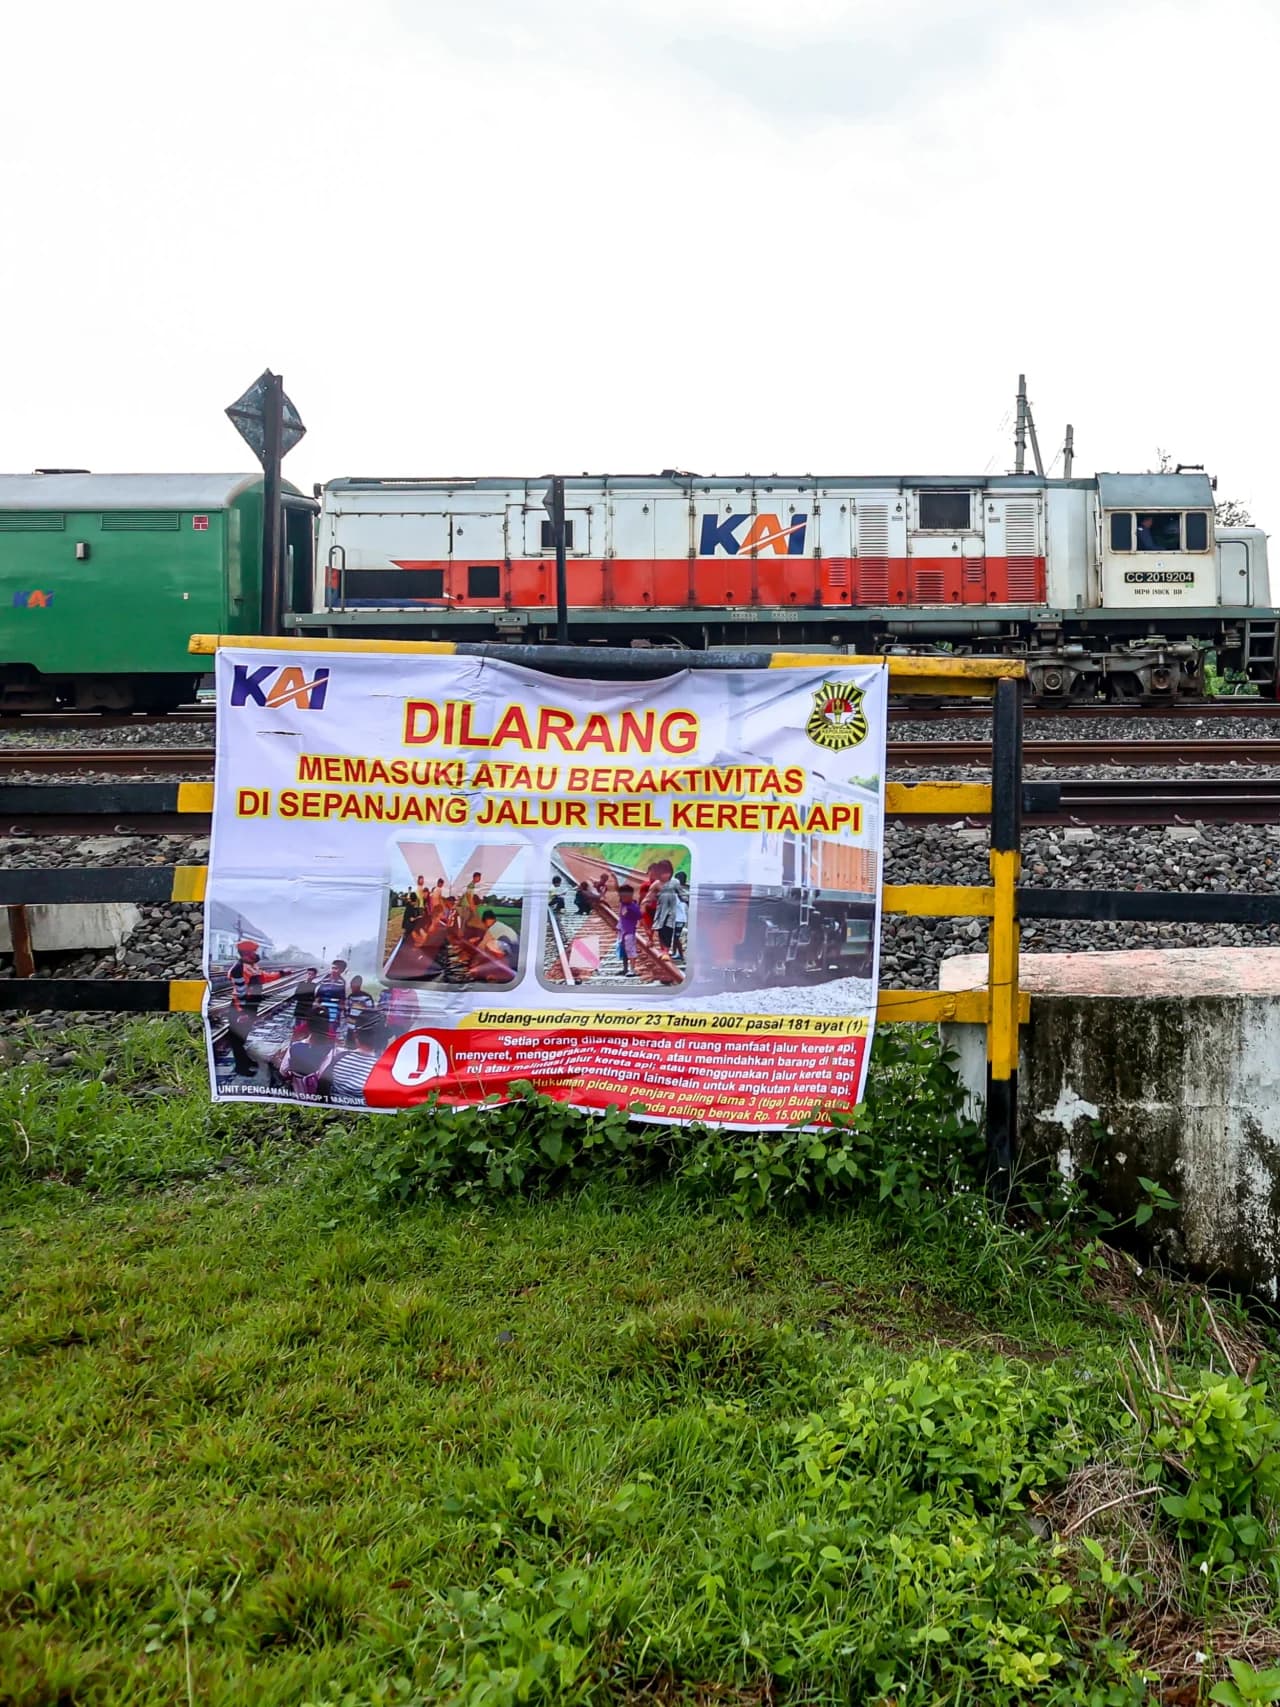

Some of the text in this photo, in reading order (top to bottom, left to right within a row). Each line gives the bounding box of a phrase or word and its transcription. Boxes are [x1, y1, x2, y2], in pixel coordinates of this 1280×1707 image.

[699, 513, 808, 556] KAI
[1126, 572, 1193, 582] CC 2019204
[12, 590, 56, 608] KAI
[230, 664, 330, 711] KAI
[402, 700, 699, 755] DILARANG
[297, 755, 804, 795] MEMASUKI ATAU BERAKTIVITAS
[237, 789, 861, 834] DI SEPANJANG JALUR REL KERETA API
[477, 1011, 863, 1034] Undang-undang Nomor 23 Tahun 2007 pasal 181 ayat (1)
[455, 1050, 513, 1062] menyeret,
[666, 1053, 693, 1064] atau
[695, 1054, 775, 1067] memindahkan
[777, 1056, 816, 1069] barang
[818, 1056, 830, 1067] di
[832, 1056, 856, 1068] atas
[543, 1036, 578, 1048] orang
[581, 1036, 629, 1048] dilarang
[632, 1037, 672, 1049] berada
[674, 1038, 686, 1049] di
[688, 1040, 721, 1053] ruang
[724, 1041, 770, 1053] manfaat
[772, 1042, 799, 1056] jalur
[801, 1043, 836, 1054] kereta
[484, 1064, 511, 1074] atau
[565, 1055, 593, 1068] jalur
[595, 1056, 631, 1069] kereta
[659, 1063, 686, 1074] atau
[688, 1066, 770, 1081] menggunakan
[771, 1069, 798, 1082] jalur
[799, 1069, 833, 1081] kereta
[835, 1071, 854, 1083] api
[531, 1065, 565, 1076] untuk
[567, 1065, 641, 1081] kepentingan
[703, 1080, 736, 1092] untuk
[738, 1084, 791, 1096] angkutan
[793, 1082, 828, 1094] kereta
[830, 1084, 851, 1097] api.
[217, 1085, 239, 1094] UNIT
[586, 1079, 629, 1094] pidana
[629, 1086, 676, 1100] penjara
[677, 1091, 715, 1105] paling
[717, 1094, 746, 1106] lama
[748, 1096, 756, 1107] 3
[758, 1096, 786, 1109] (tiga)
[788, 1095, 822, 1108] Bulan
[667, 1104, 706, 1118] paling
[753, 1110, 771, 1122] Rp.
